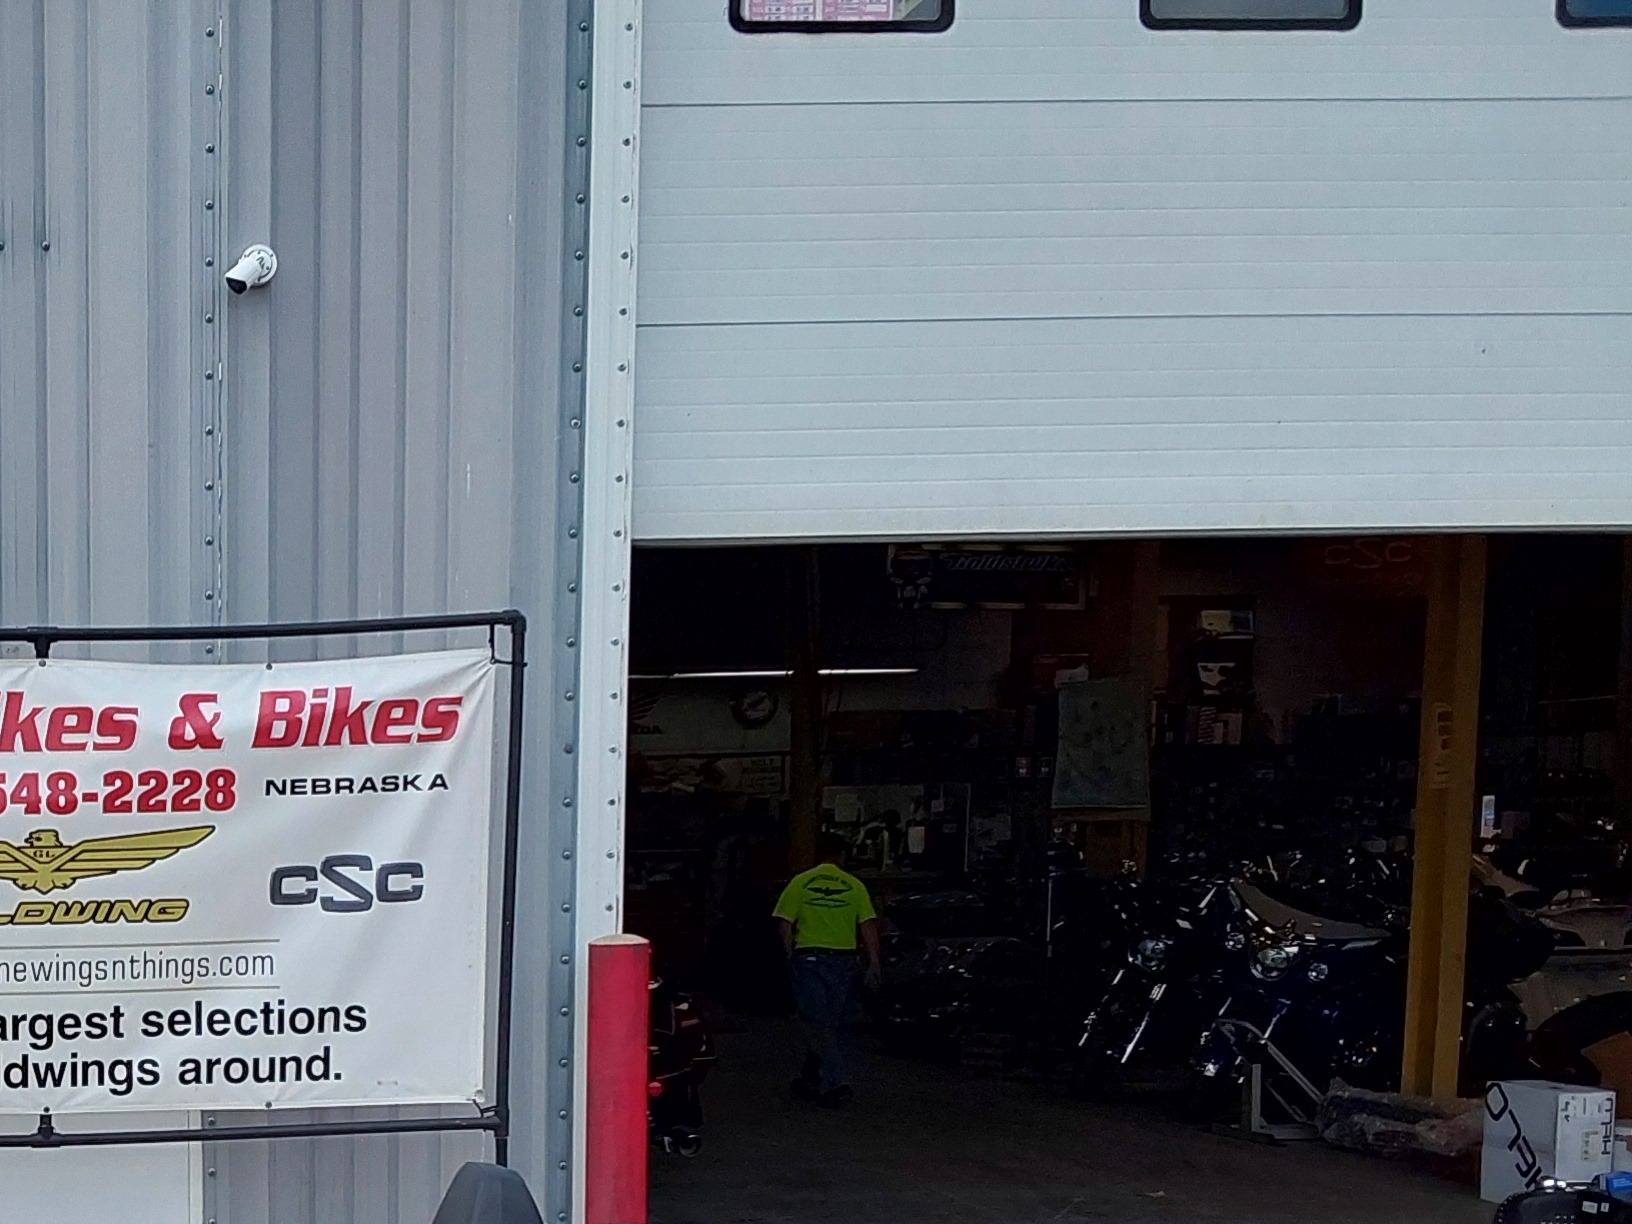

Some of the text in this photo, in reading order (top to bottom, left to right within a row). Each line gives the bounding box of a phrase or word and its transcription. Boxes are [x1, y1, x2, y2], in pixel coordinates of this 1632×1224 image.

[168, 692, 224, 750] &
[252, 686, 464, 748] Bikes
[264, 773, 449, 796] NEBRASKA
[140, 999, 367, 1038] selections
[178, 1048, 342, 1086] around.
